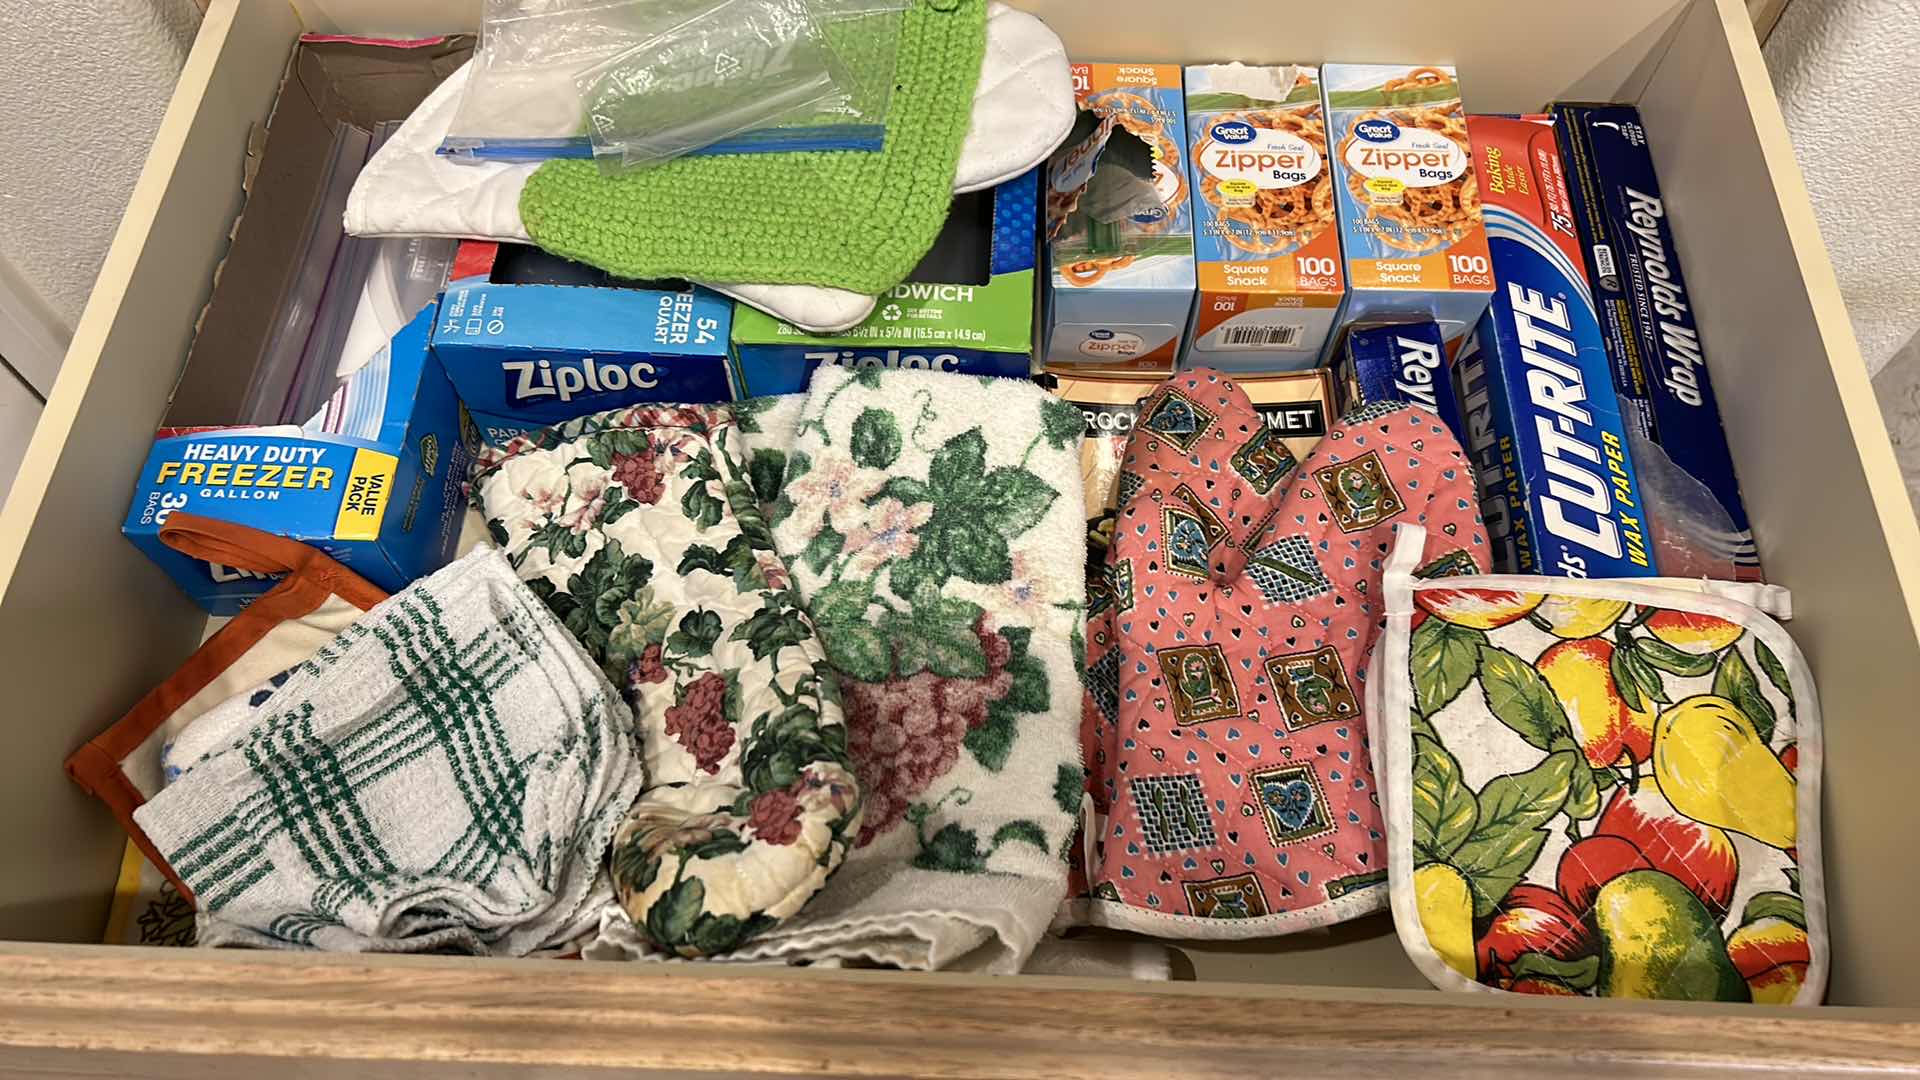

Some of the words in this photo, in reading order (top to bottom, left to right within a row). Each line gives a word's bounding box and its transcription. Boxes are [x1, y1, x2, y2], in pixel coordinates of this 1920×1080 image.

[1072, 76, 1090, 90] 10
[1215, 126, 1249, 135] Great
[1359, 124, 1392, 134] Great
[1215, 150, 1305, 172] Zipper
[1360, 148, 1450, 170] Zipper
[1485, 144, 1505, 195] Baking
[1273, 170, 1306, 182] Bags
[1419, 169, 1453, 180] Bags
[1504, 164, 1517, 191] Made
[1517, 165, 1528, 195] Easier
[1551, 211, 1575, 238] 75
[1224, 264, 1269, 275] Square
[1297, 257, 1335, 275] 100
[1376, 261, 1421, 272] Square
[1448, 255, 1488, 273] 100
[1629, 253, 1643, 291] TRUSTED
[1227, 276, 1268, 286] Snack
[1300, 276, 1337, 287] BAGS
[1380, 273, 1421, 283] Snack
[1454, 274, 1490, 285] BAGS
[888, 284, 974, 302] DWICH
[1625, 186, 1687, 321] Reynolds
[1659, 321, 1703, 406] Wrap
[1214, 301, 1236, 311] 100
[1637, 293, 1649, 321] SINCE
[654, 296, 673, 344] QUART
[670, 293, 694, 344] EEZER
[694, 317, 718, 344] 54
[913, 327, 934, 339] (16.5
[934, 330, 945, 339] cm
[954, 329, 971, 340] 14.9
[971, 330, 986, 341] cm)
[1641, 321, 1653, 341] 1947
[502, 358, 658, 401] Ziploc
[1394, 335, 1441, 416] Rey
[1508, 282, 1623, 559] CUT-RITE
[184, 443, 260, 461] HEAVY
[264, 445, 326, 465] DUTY
[156, 462, 335, 490] FREEZER
[1503, 436, 1521, 508] PAPER
[1601, 430, 1632, 506] PAPER
[200, 488, 280, 500] GALLON
[345, 476, 368, 511] PACK
[361, 473, 385, 515] VALUE
[140, 492, 160, 524] BAGS
[1511, 518, 1533, 568] WAX
[1621, 509, 1650, 568] WAX
